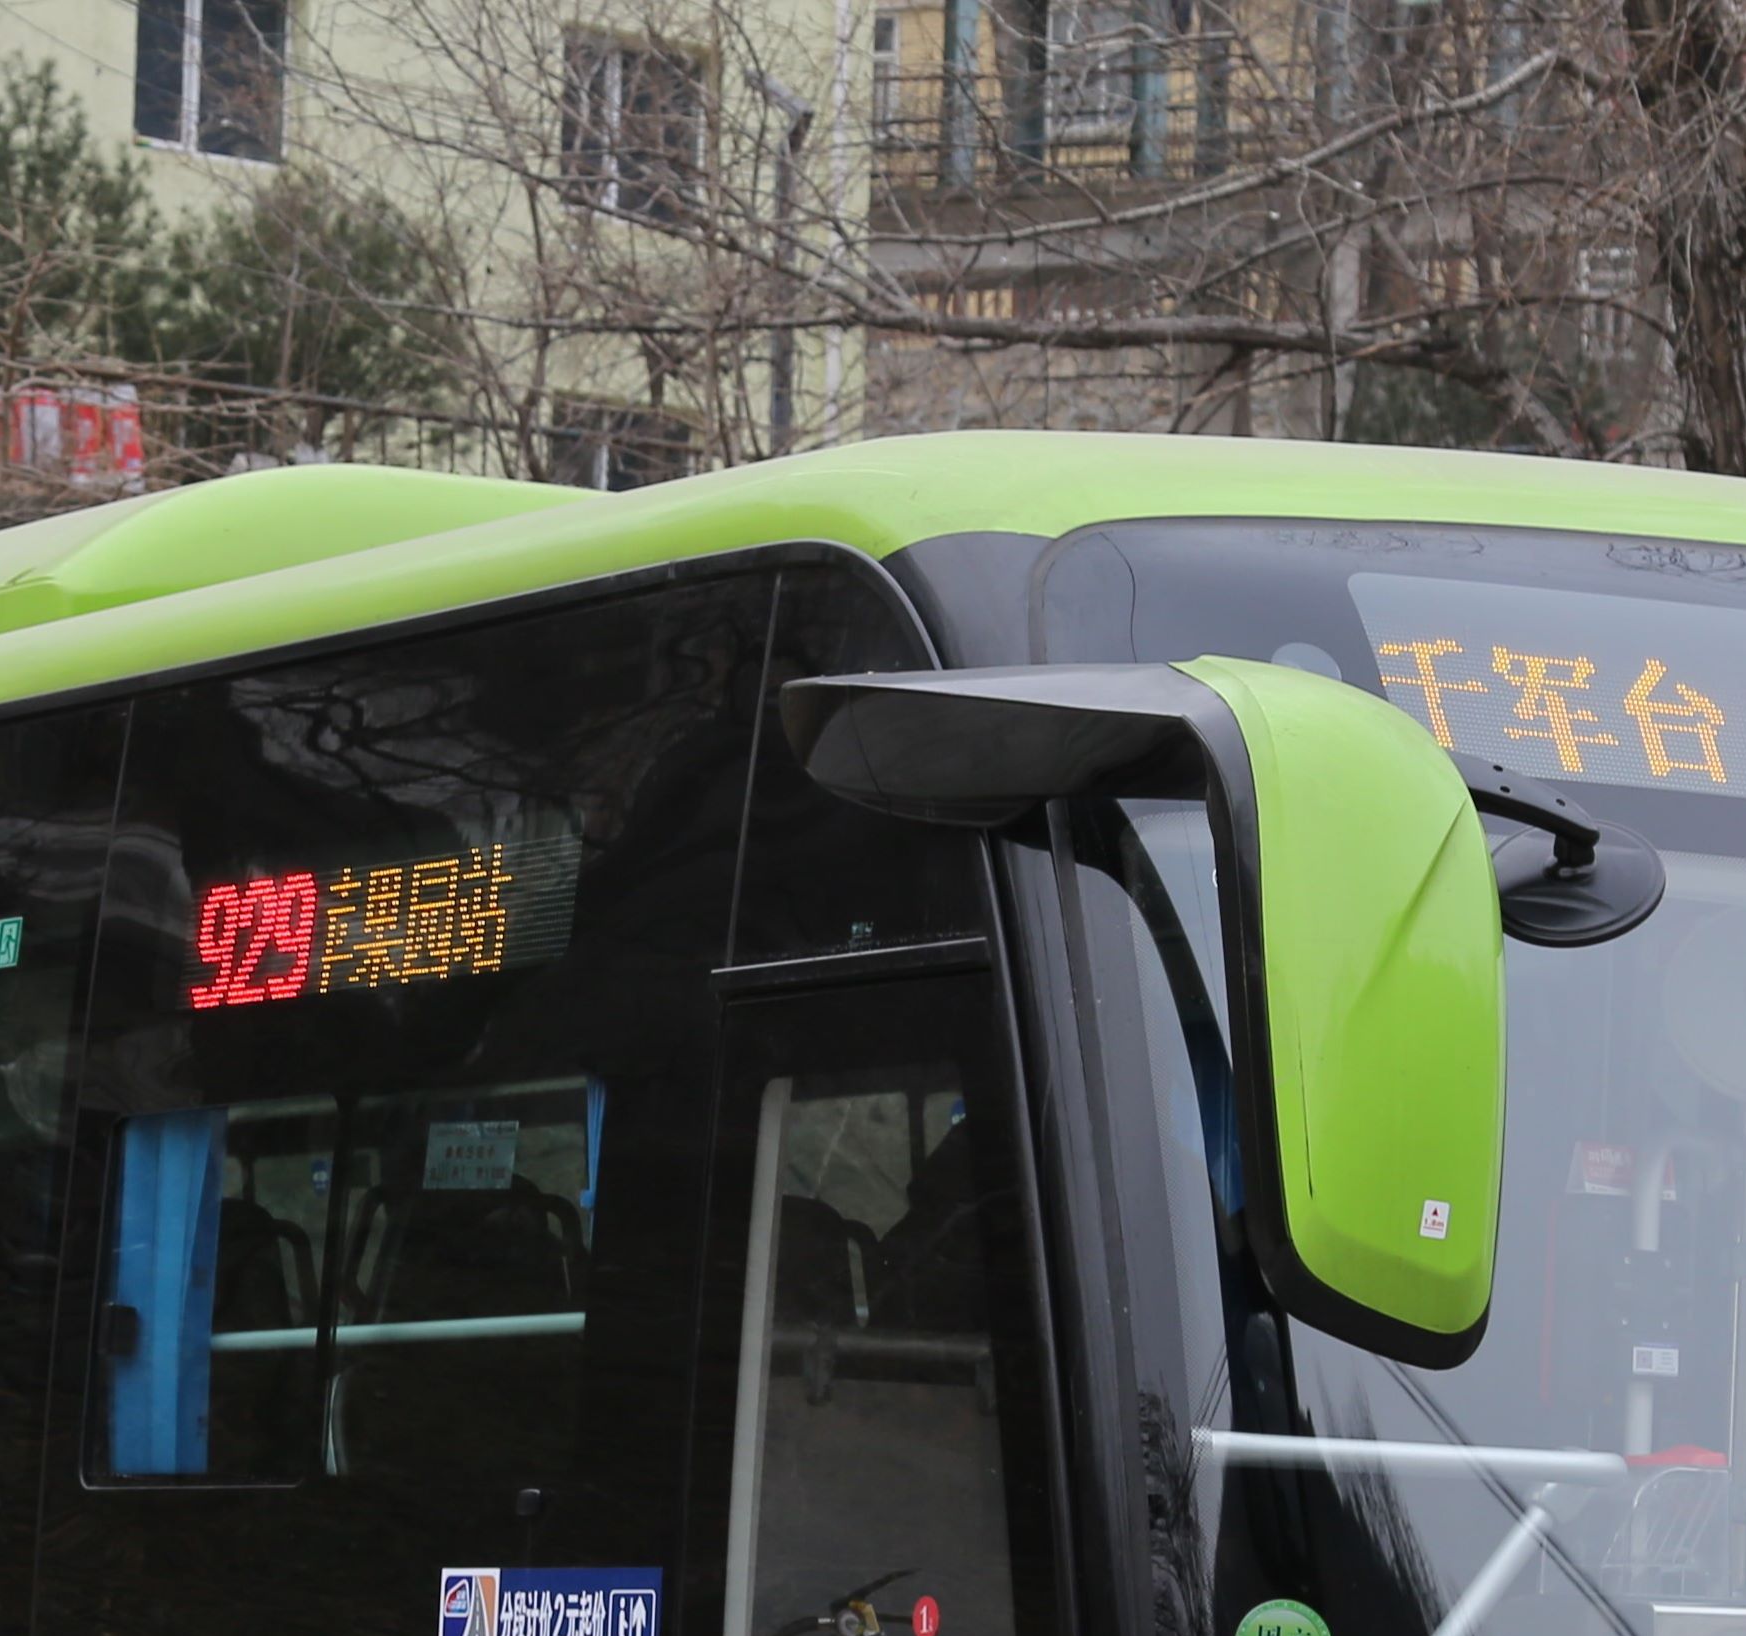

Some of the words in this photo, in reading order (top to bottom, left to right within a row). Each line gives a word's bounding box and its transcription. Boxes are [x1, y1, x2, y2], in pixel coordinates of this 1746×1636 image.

[1379, 638, 1727, 784] 千军台
[191, 871, 317, 1010] 929
